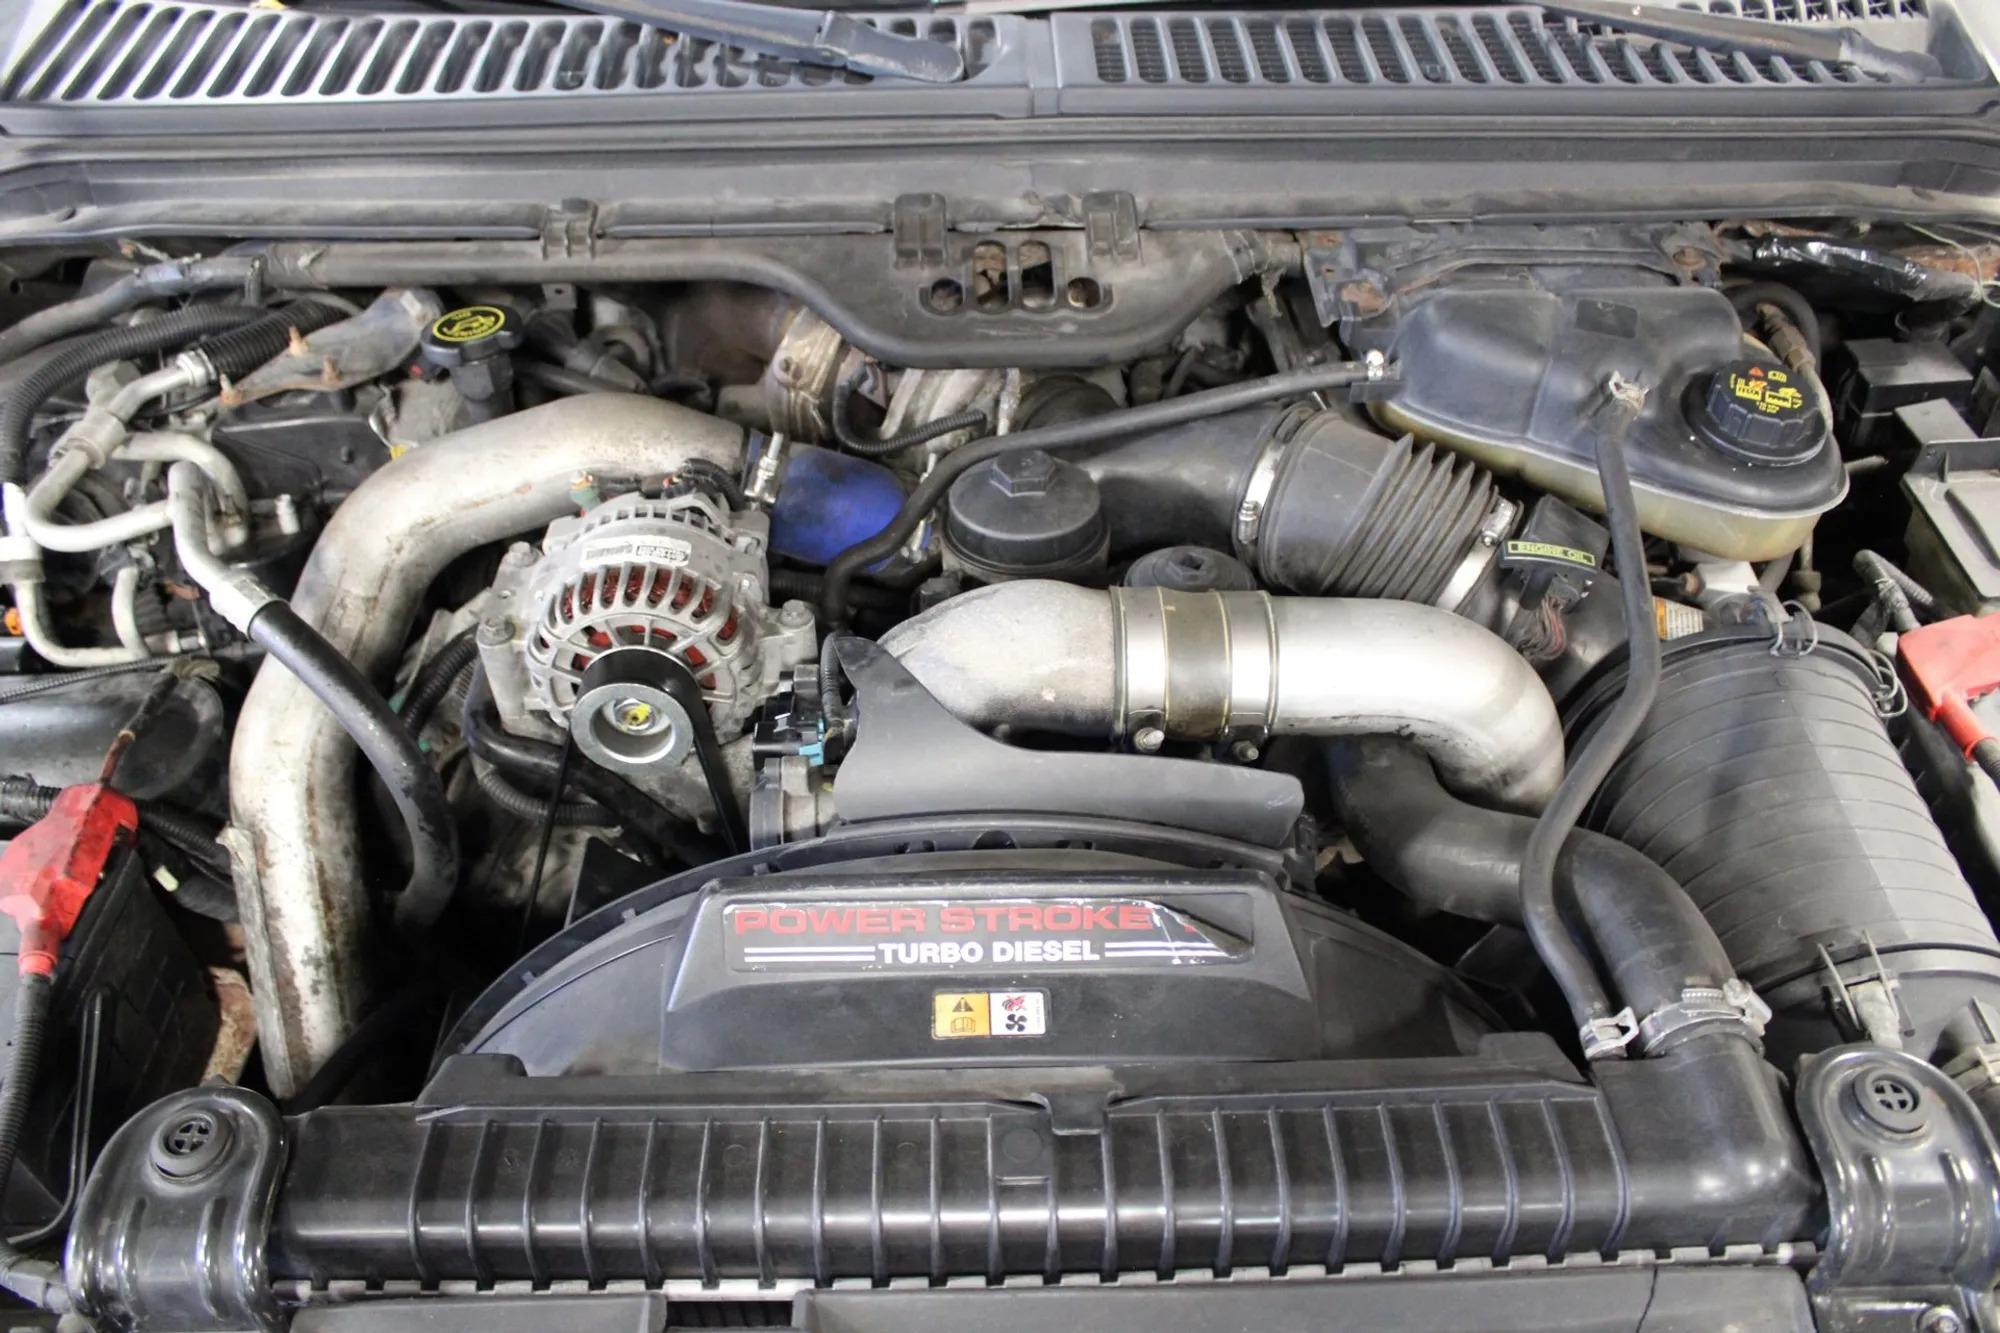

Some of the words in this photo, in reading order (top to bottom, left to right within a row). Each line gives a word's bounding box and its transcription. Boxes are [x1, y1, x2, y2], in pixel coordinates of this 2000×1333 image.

[1519, 543, 1561, 556] ENGINE
[734, 906, 926, 935] POWER
[940, 904, 1155, 933] STROKE
[878, 941, 984, 964] TURBO
[992, 939, 1100, 963] DIESEL
